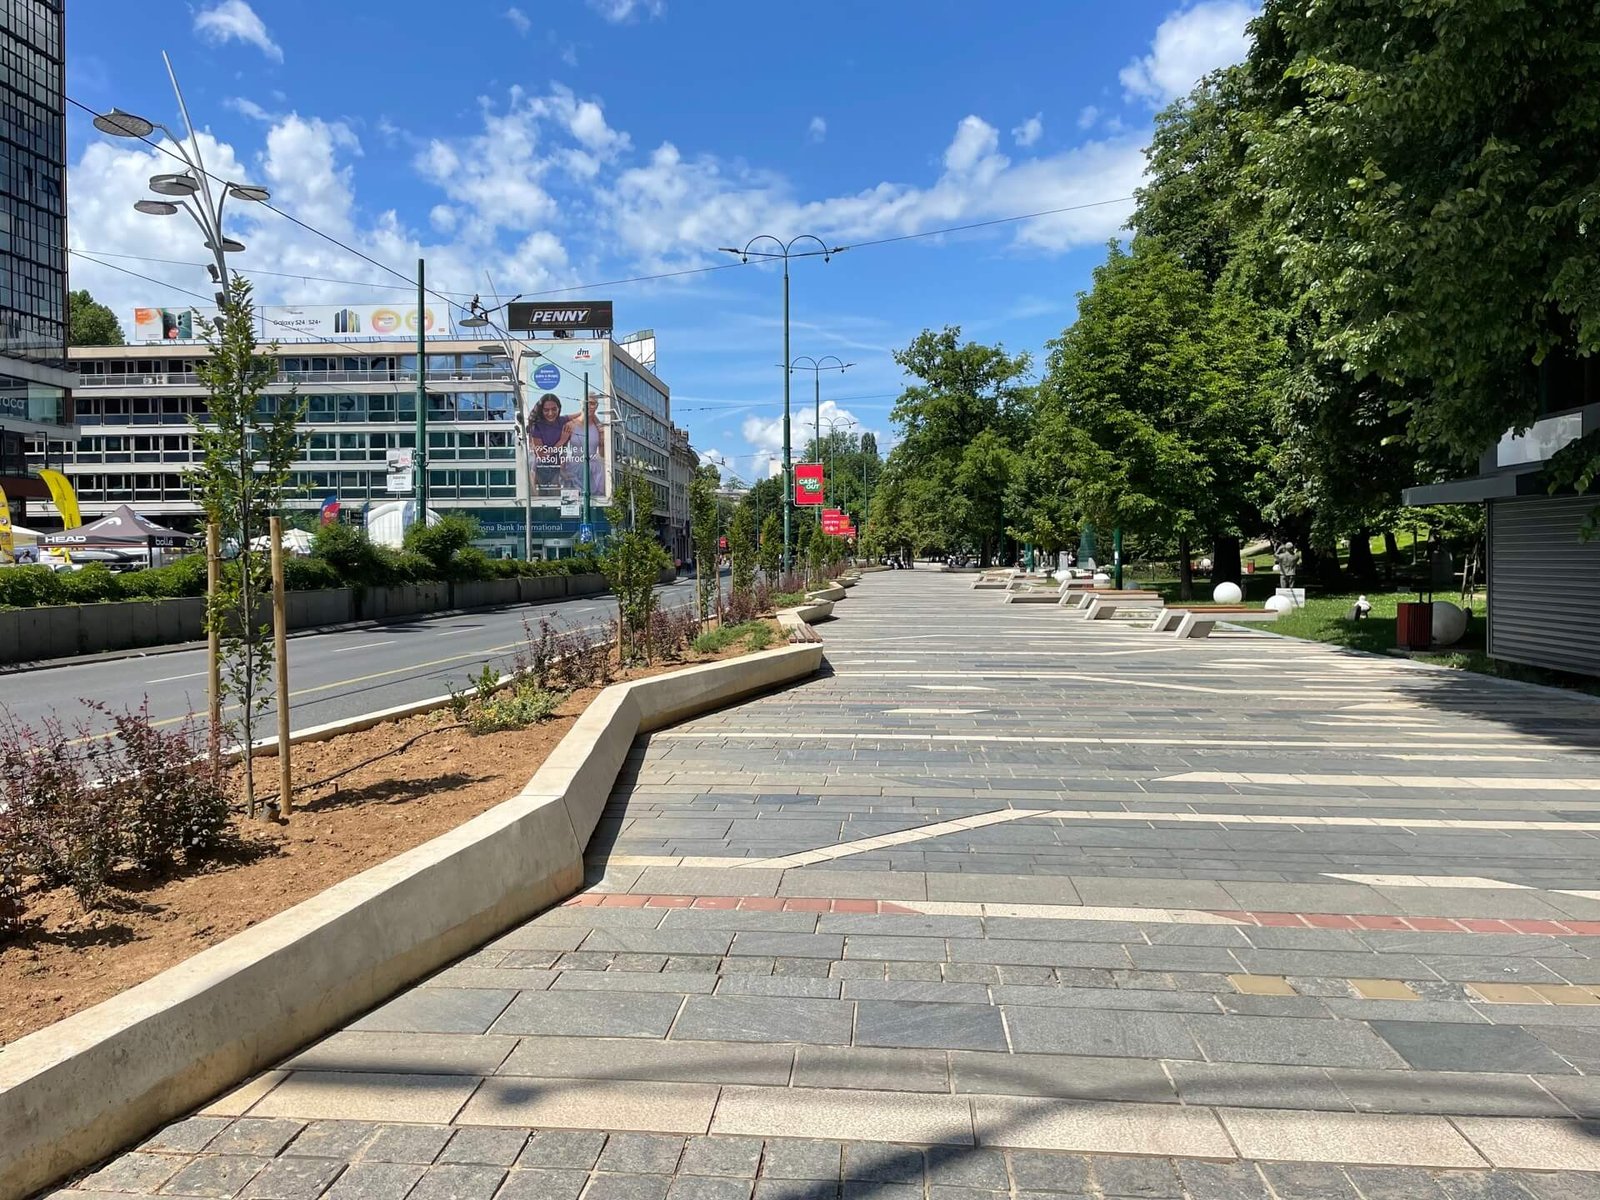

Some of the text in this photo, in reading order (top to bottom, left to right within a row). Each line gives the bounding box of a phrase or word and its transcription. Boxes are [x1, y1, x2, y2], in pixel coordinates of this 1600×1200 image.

[532, 310, 588, 322] PENNY
[536, 454, 558, 464] našoj
[517, 523, 563, 531] Intrnational
